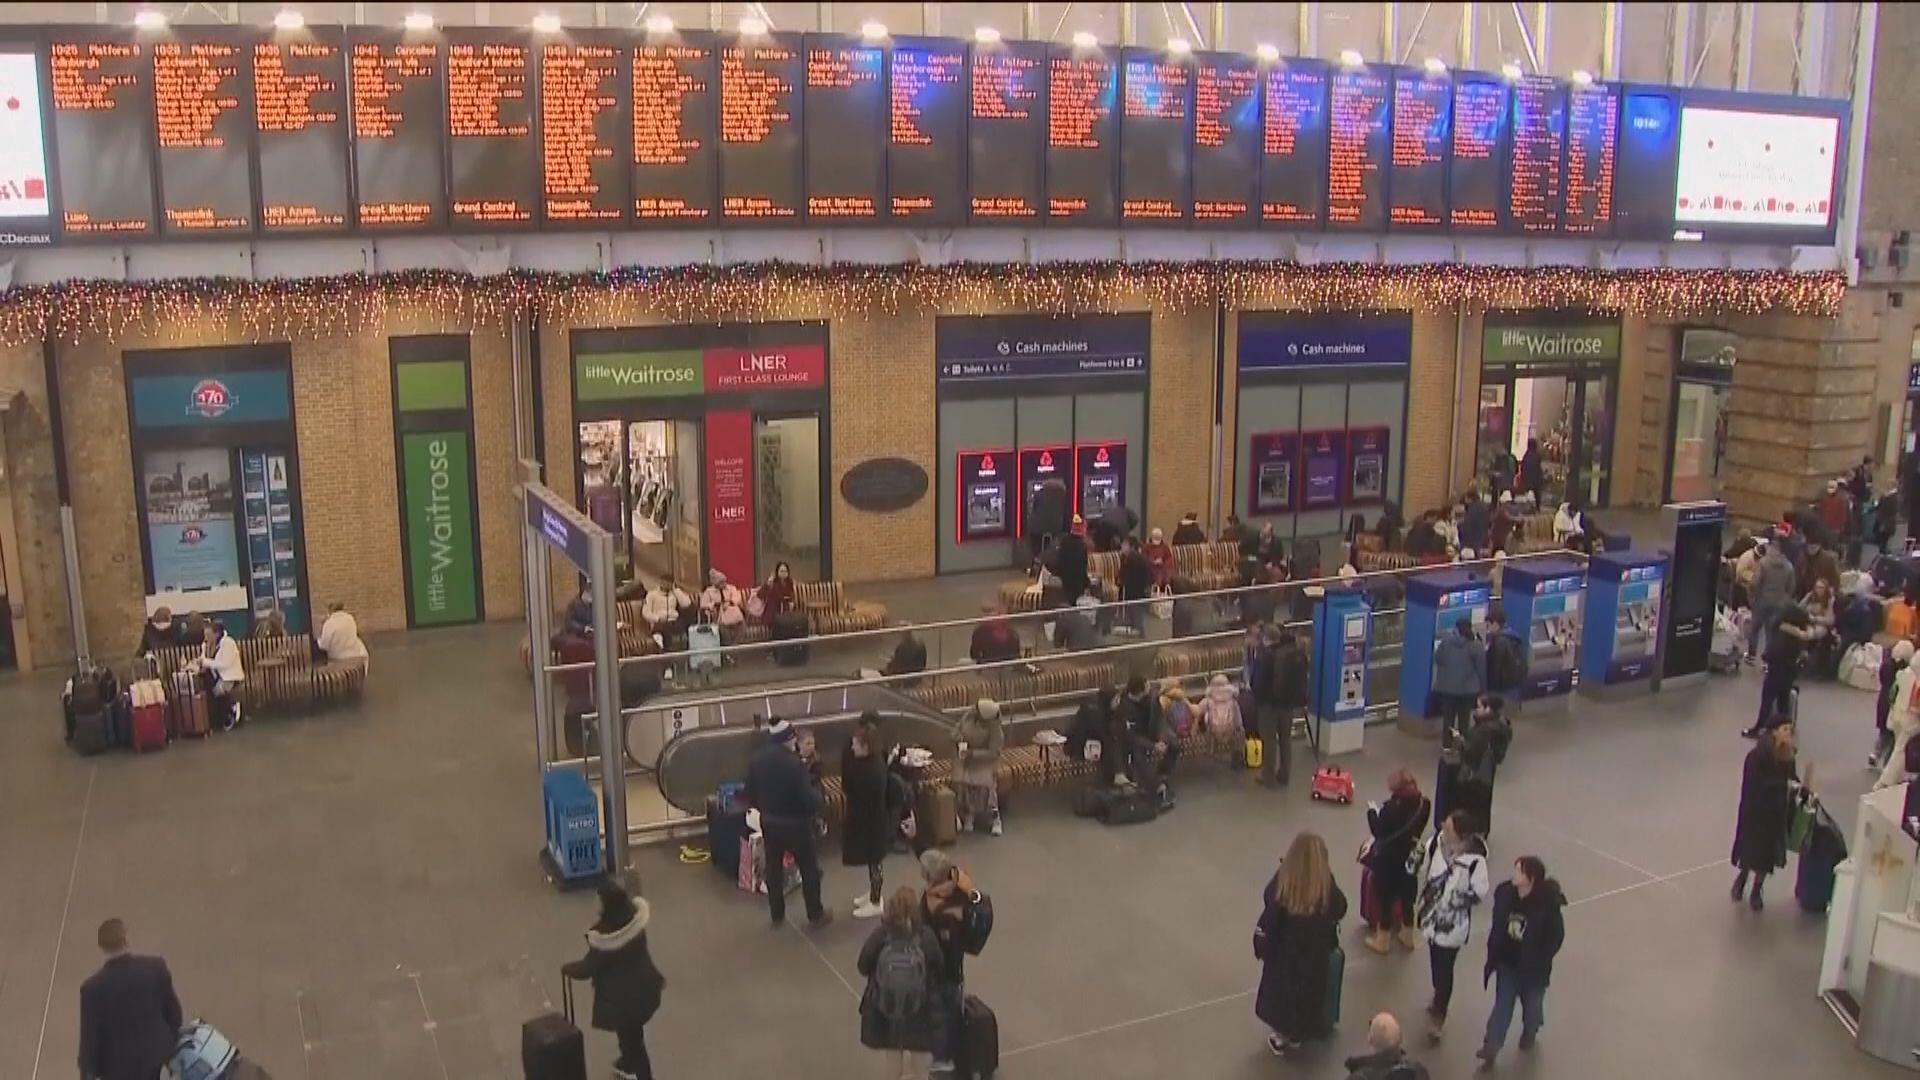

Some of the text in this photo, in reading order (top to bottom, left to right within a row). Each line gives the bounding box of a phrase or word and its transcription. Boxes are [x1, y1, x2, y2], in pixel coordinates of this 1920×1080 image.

[1016, 340, 1089, 354] Cash machines
[1302, 342, 1366, 355] Cash machines
[1502, 330, 1603, 356] little Waitrose
[740, 354, 787, 373] LNER
[586, 364, 695, 385] little Waitrose
[718, 371, 809, 385] FIRST CLASS LOUNGE
[424, 439, 453, 572] Waitrose
[714, 505, 746, 520] LNER
